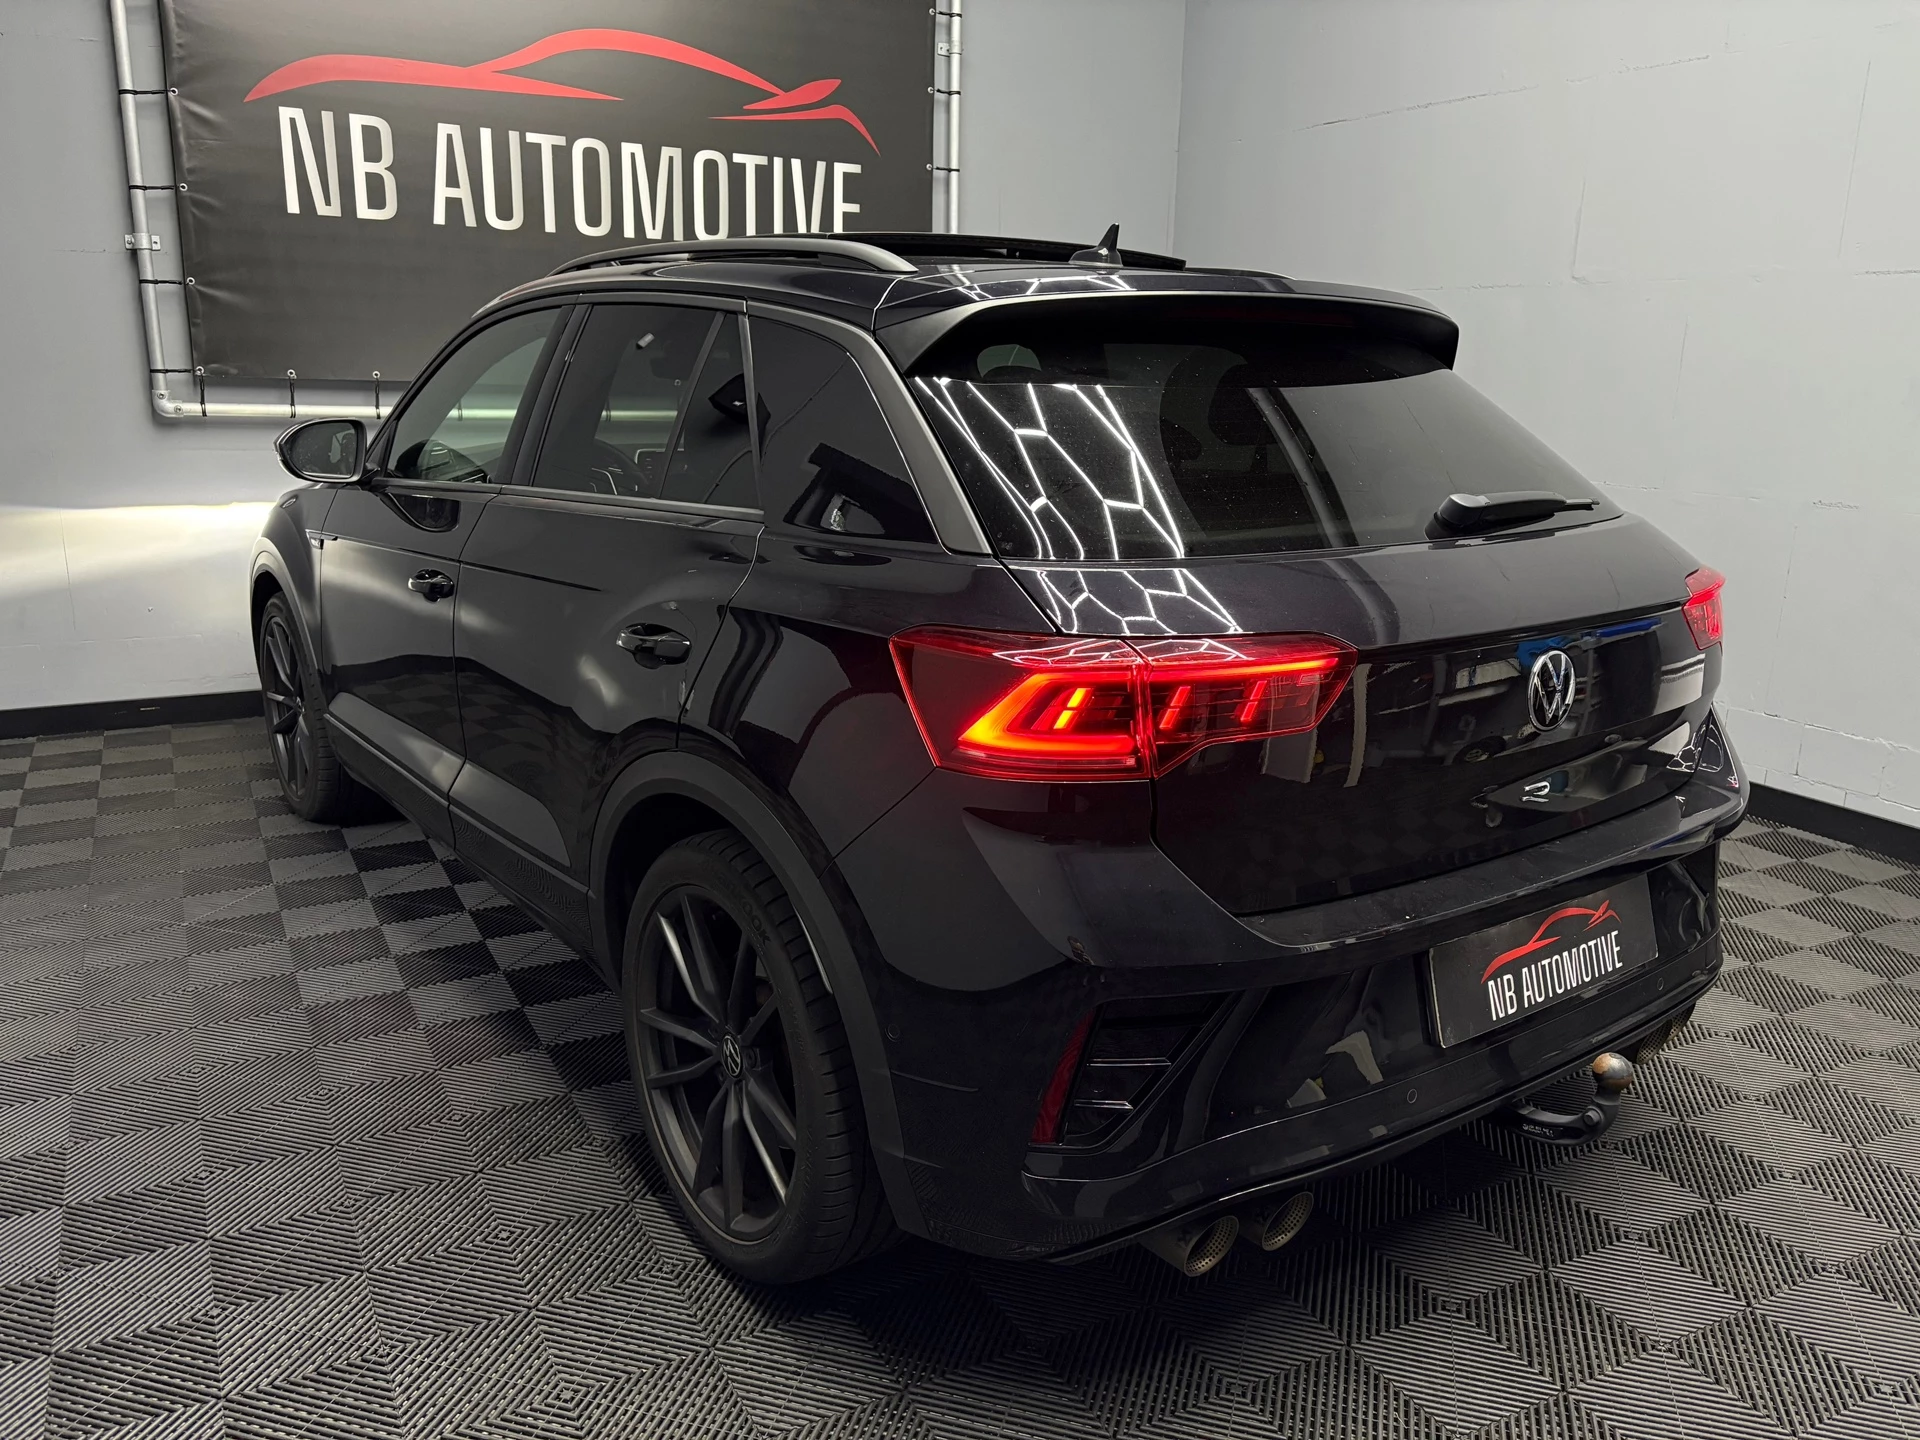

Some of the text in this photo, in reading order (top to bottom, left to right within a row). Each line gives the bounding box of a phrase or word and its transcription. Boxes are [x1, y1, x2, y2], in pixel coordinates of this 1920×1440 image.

[278, 106, 862, 241] NB AUTOMOTIVE
[1487, 930, 1623, 1021] NB AUTOMOTIVE
